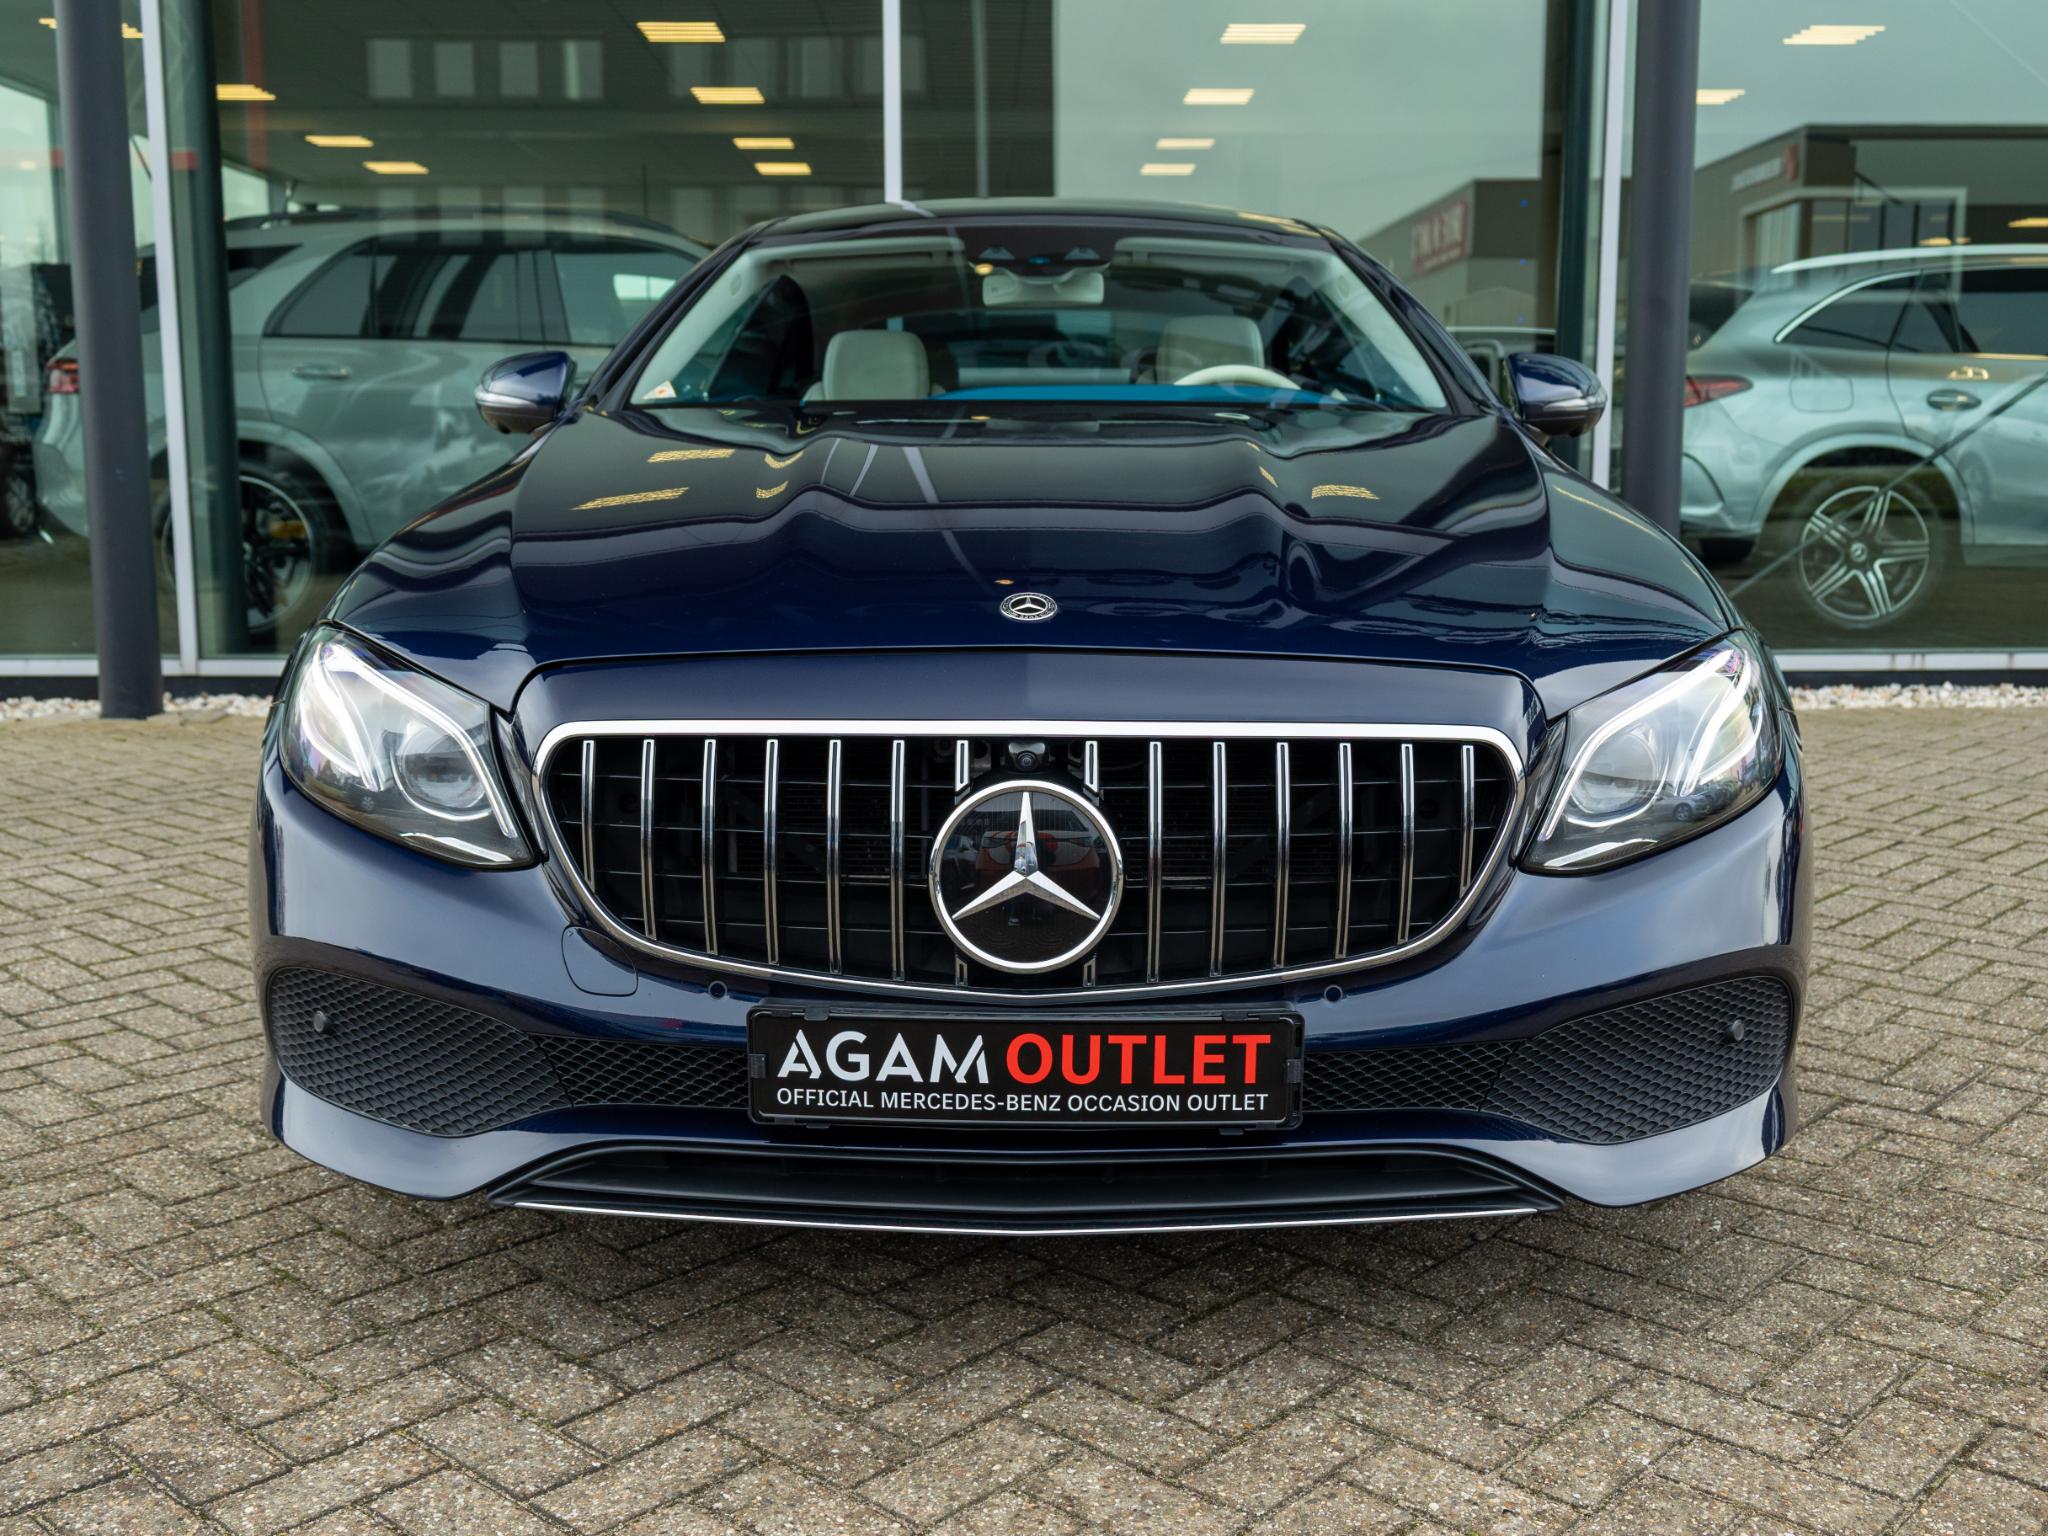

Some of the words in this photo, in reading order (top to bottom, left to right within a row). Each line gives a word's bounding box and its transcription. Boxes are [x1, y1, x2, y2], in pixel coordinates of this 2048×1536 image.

[776, 1029, 990, 1084] AGAM
[1005, 1032, 1272, 1085] OUTLET
[776, 1087, 874, 1108] OFFICIAL
[881, 1091, 1061, 1112] MERCEDES-BENZ
[1067, 1094, 1180, 1112] OCCASION
[1187, 1093, 1269, 1112] OUTLET
